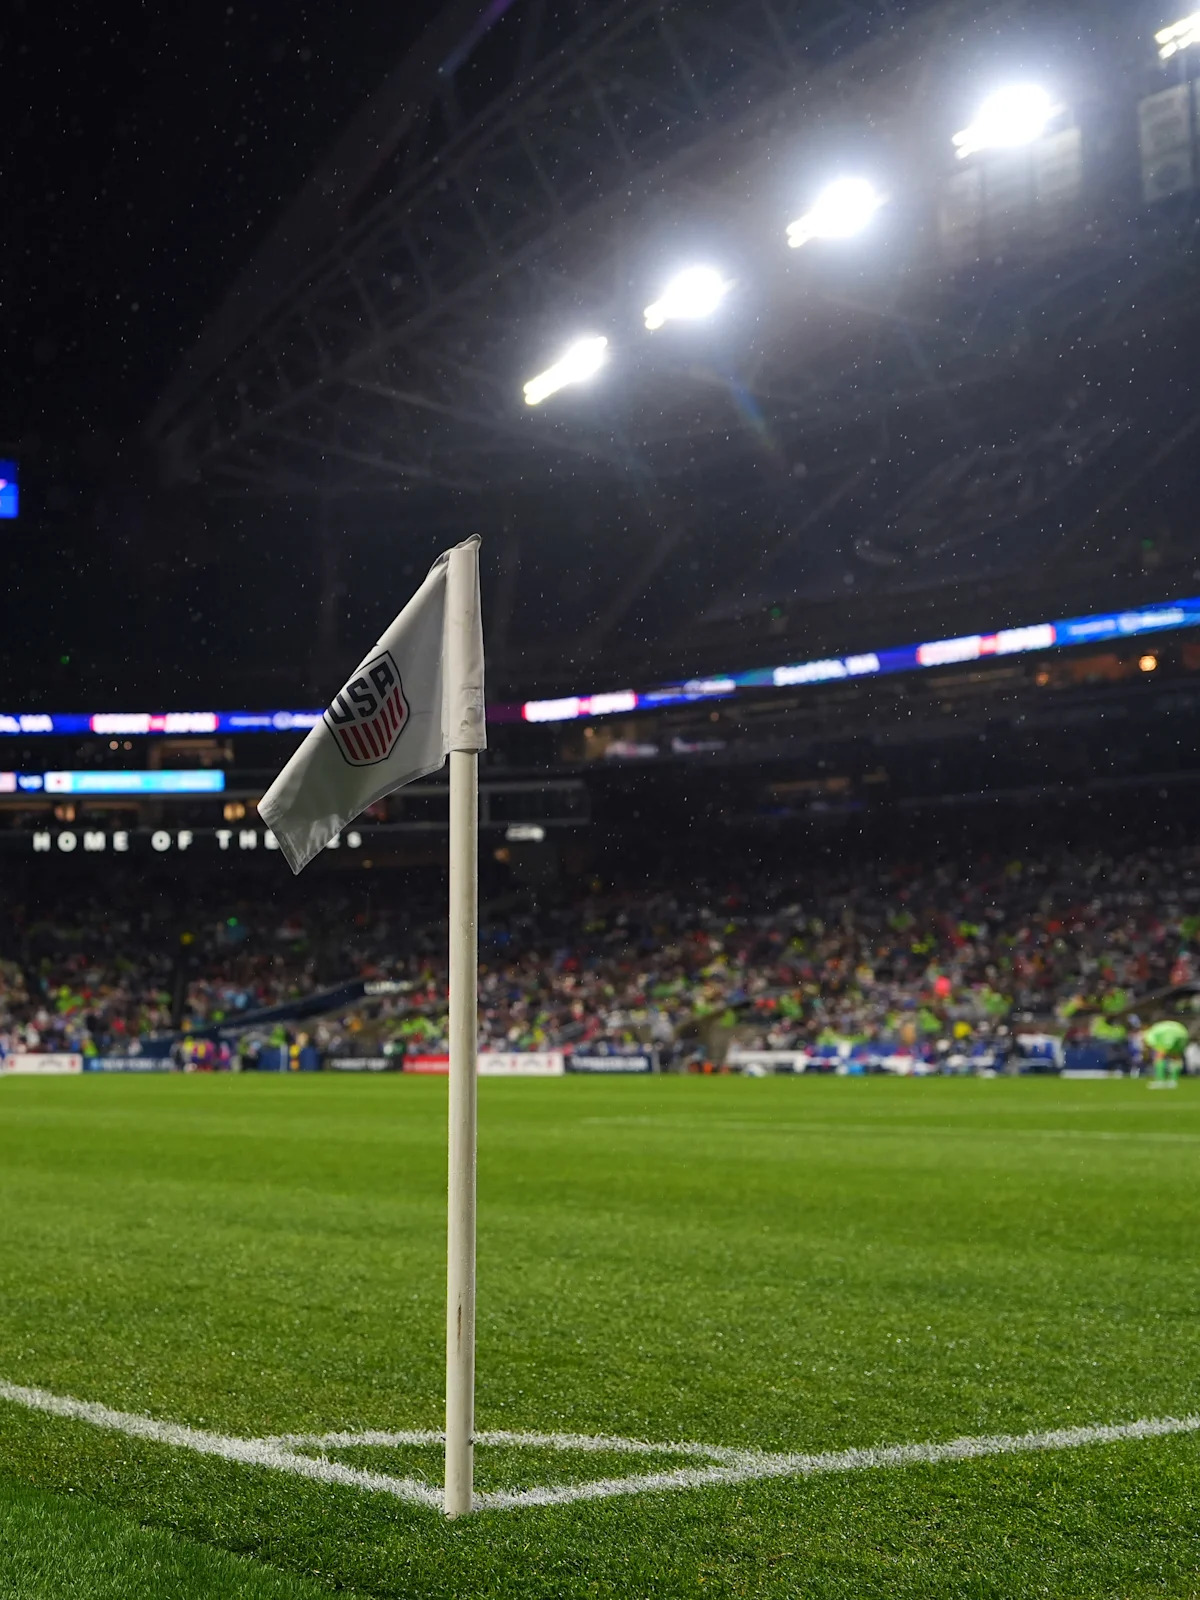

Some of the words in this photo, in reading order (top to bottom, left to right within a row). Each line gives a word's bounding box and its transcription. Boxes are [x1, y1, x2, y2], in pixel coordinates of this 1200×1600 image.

[328, 661, 396, 725] USA
[32, 830, 129, 852] HOME
[151, 830, 193, 852] OF
[215, 829, 280, 851] THE
